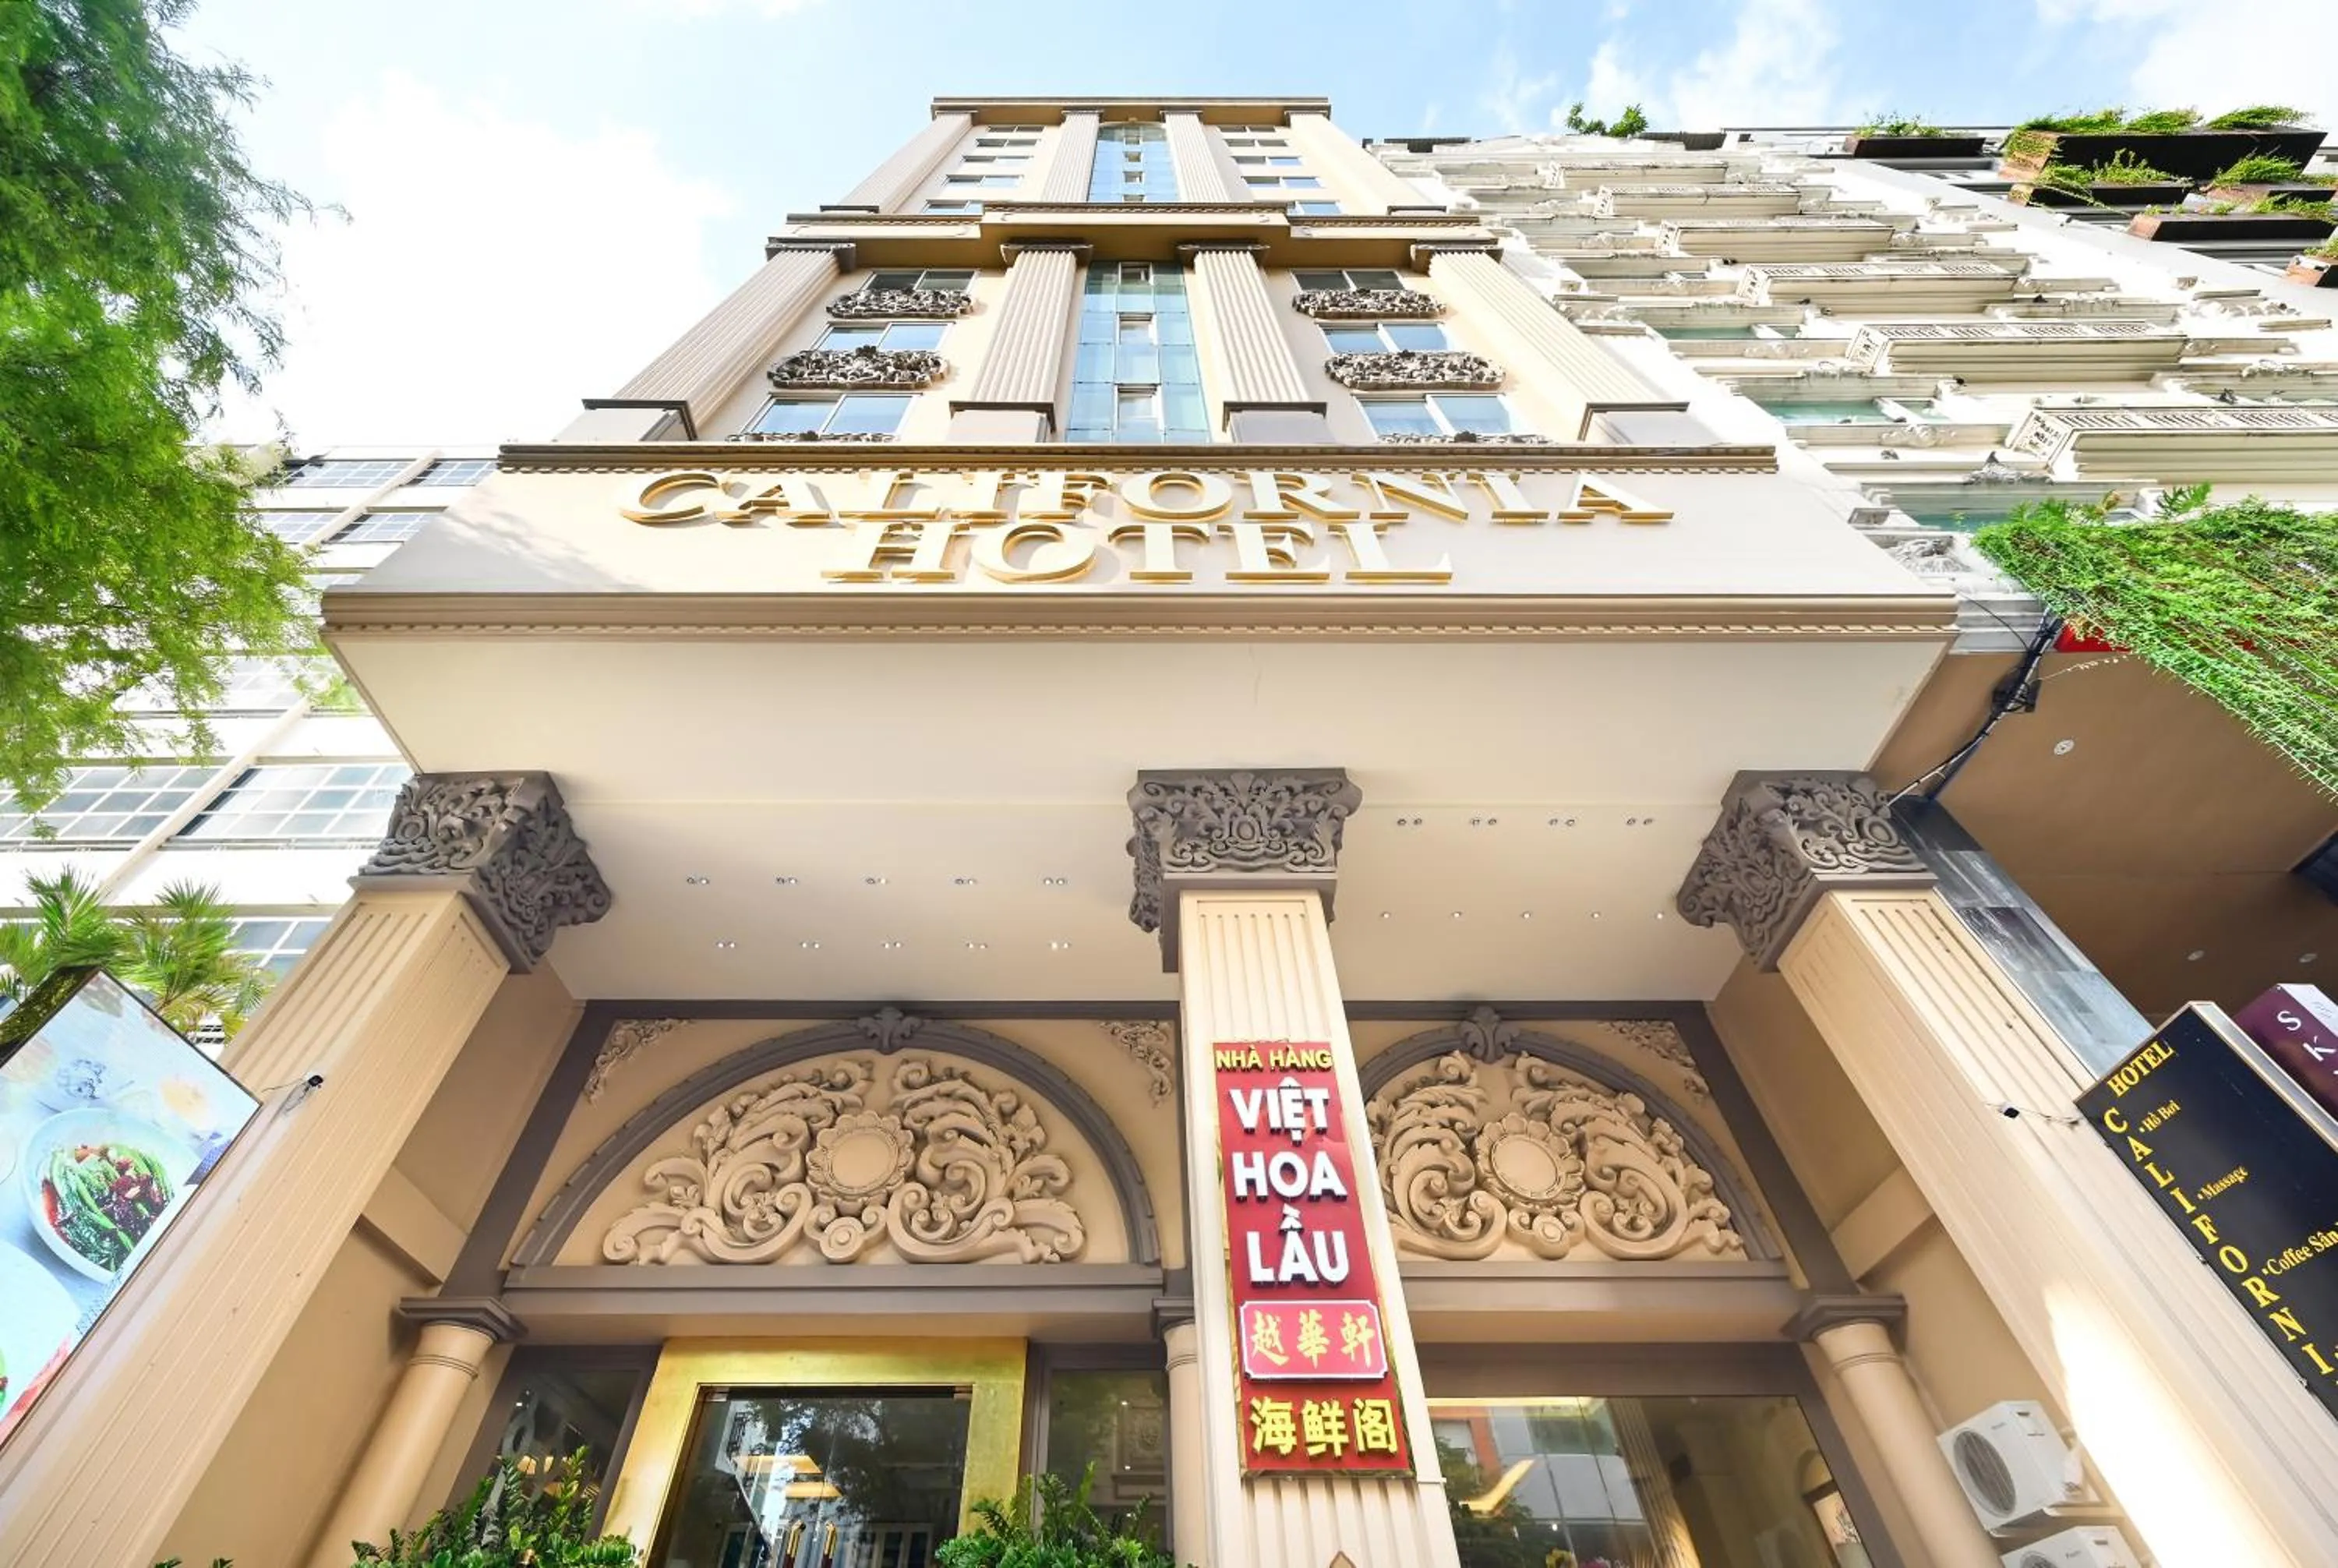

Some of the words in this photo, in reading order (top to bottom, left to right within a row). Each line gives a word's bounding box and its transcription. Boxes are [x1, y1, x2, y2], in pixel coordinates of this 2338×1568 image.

[620, 469, 1676, 524] CALIFORNIA
[821, 521, 1453, 584] HOTEL
[1216, 1045, 1263, 1072] NHÀ
[1269, 1045, 1333, 1072] HÀNG
[2107, 1040, 2175, 1097] HOTEL
[2276, 1010, 2338, 1075] SK
[1229, 1076, 1330, 1146] VIỆT
[1232, 1150, 1348, 1202] HOA
[2200, 1166, 2249, 1200] Massage
[1245, 1203, 1351, 1288] LẦU
[2104, 1107, 2338, 1386] CALIFORNI
[2266, 1247, 2314, 1276] Coffee
